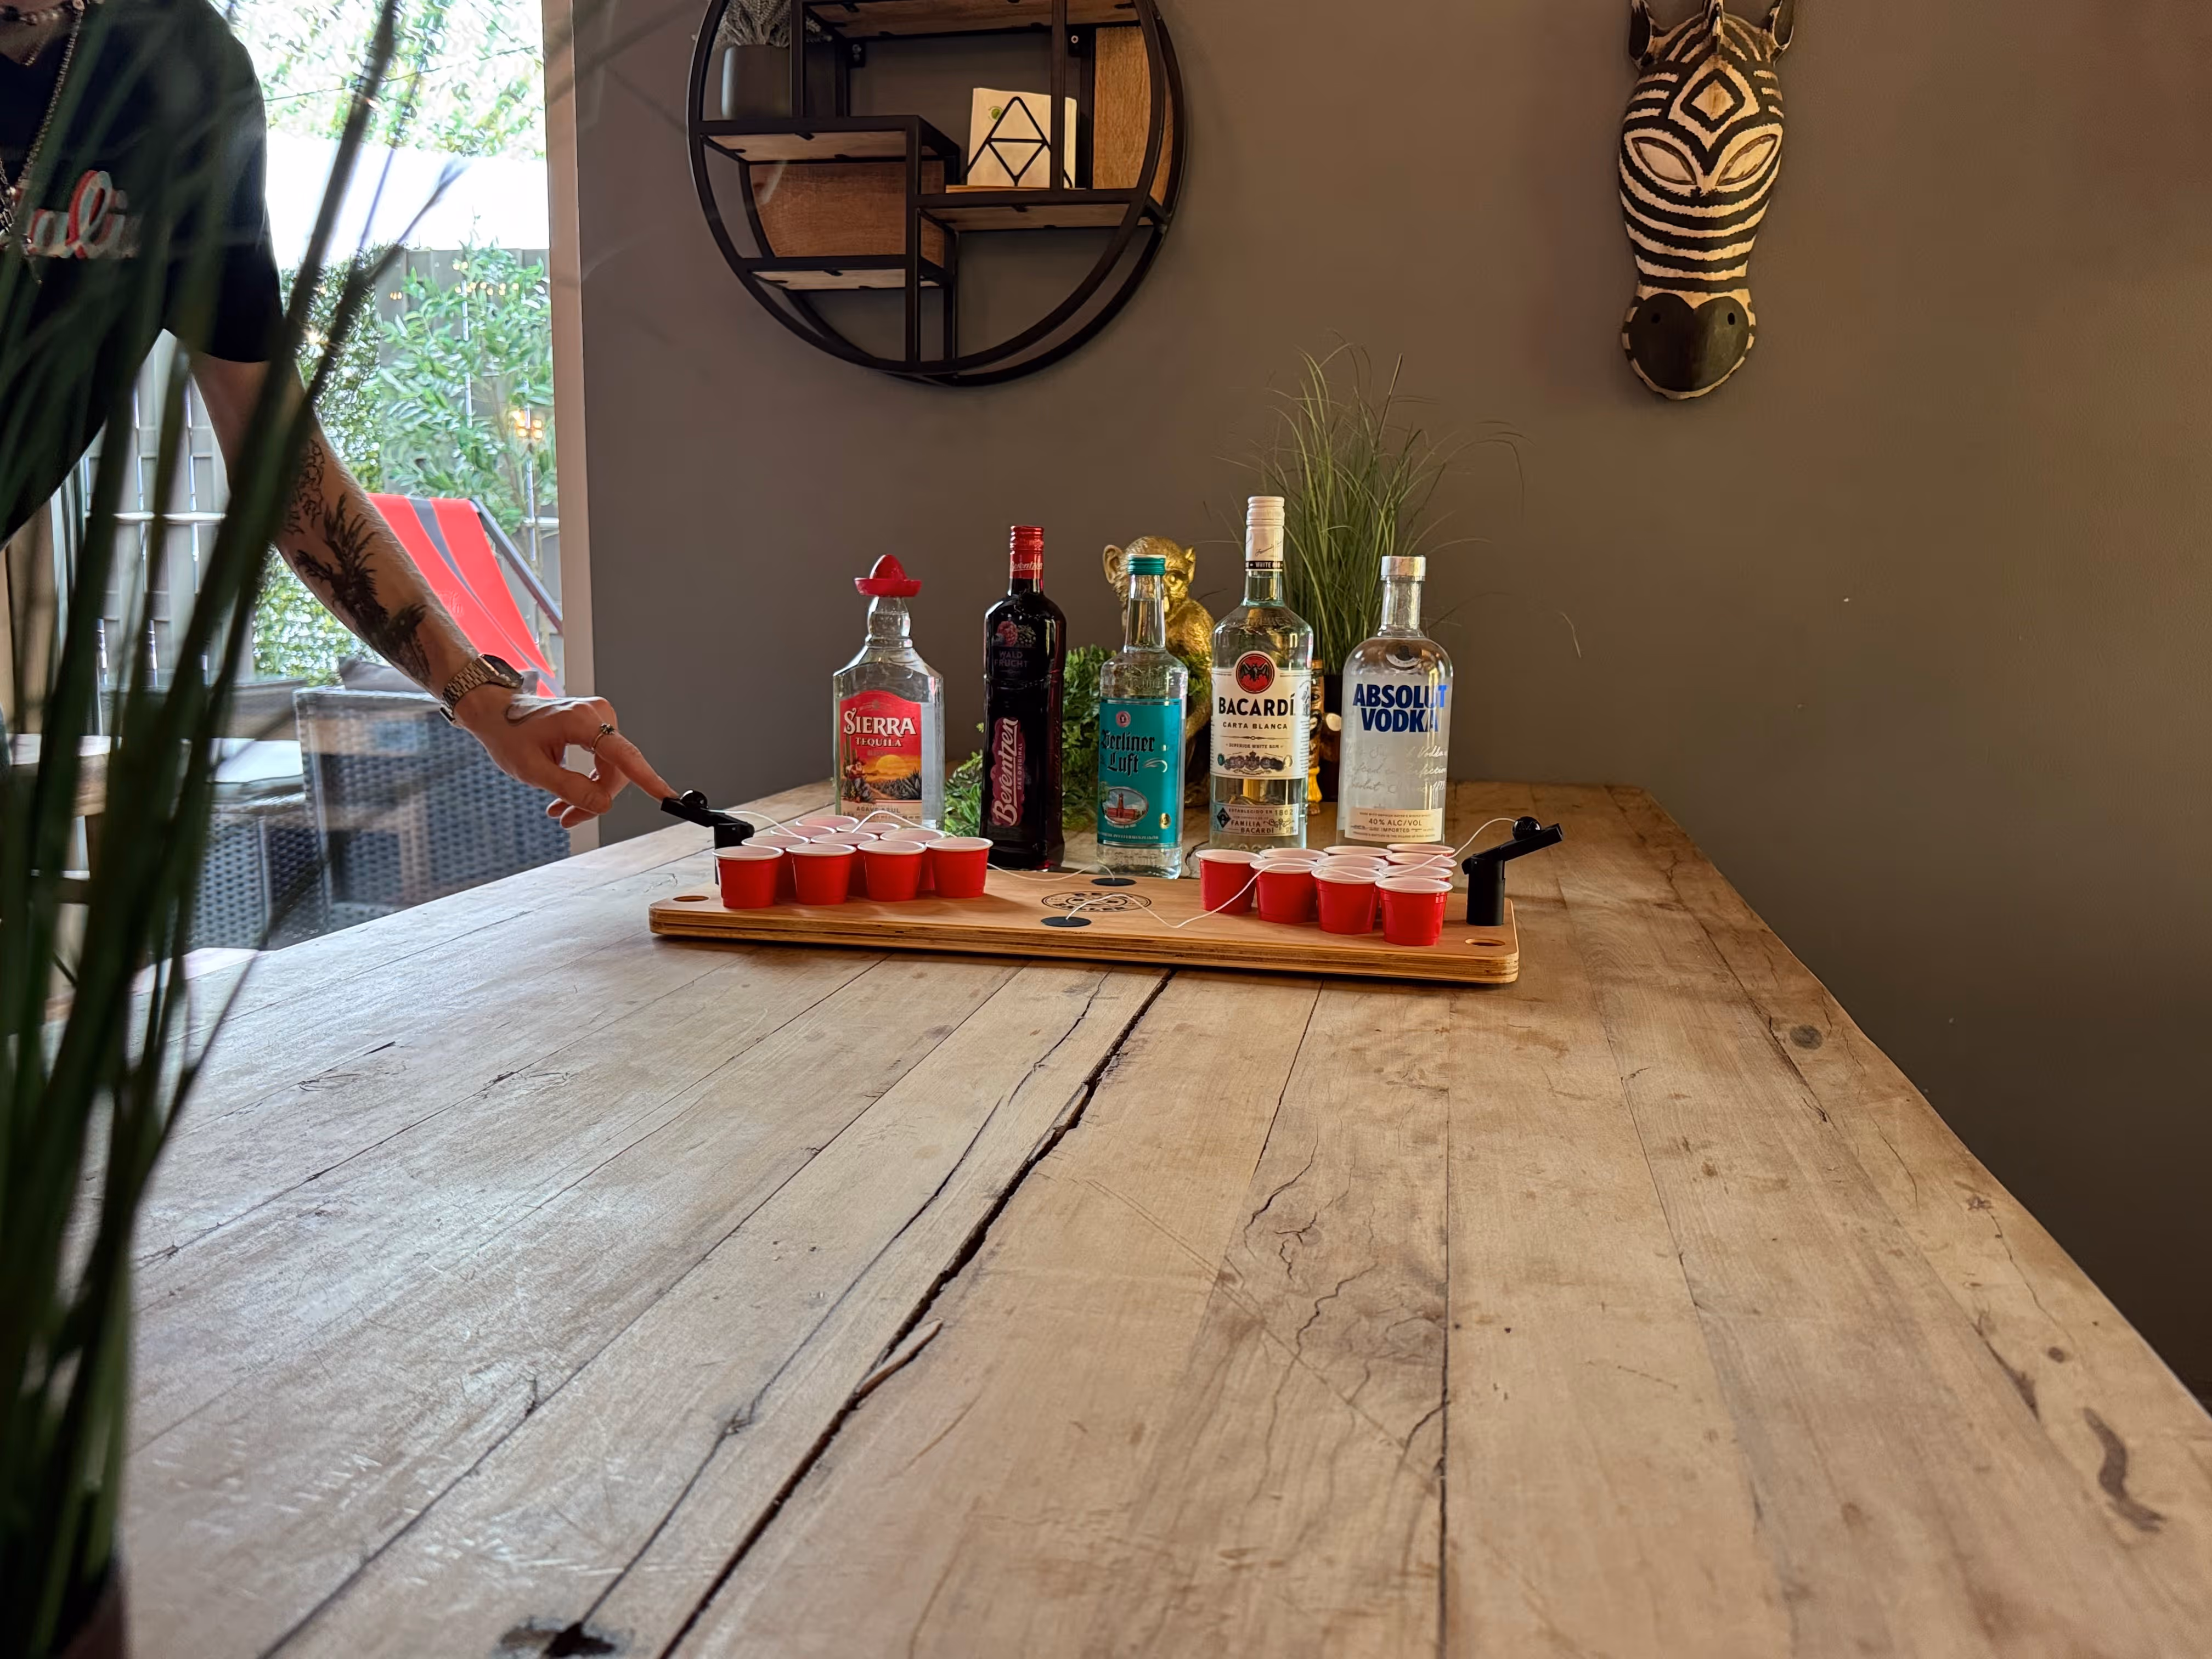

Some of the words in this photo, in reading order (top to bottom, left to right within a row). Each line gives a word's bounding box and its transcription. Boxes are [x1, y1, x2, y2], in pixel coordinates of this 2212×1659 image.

[994, 659, 1027, 668] FRUCHT
[1000, 651, 1023, 659] WALD
[1219, 693, 1295, 716] BACARDÍ
[1353, 684, 1449, 708] ABSOLUT
[843, 707, 917, 737] SIERRA
[1361, 708, 1438, 732] VODKA
[856, 737, 902, 747] TEQUILA
[1101, 729, 1155, 752] Berliner
[992, 718, 1019, 826] Berentzen
[1107, 752, 1139, 777] Luft
